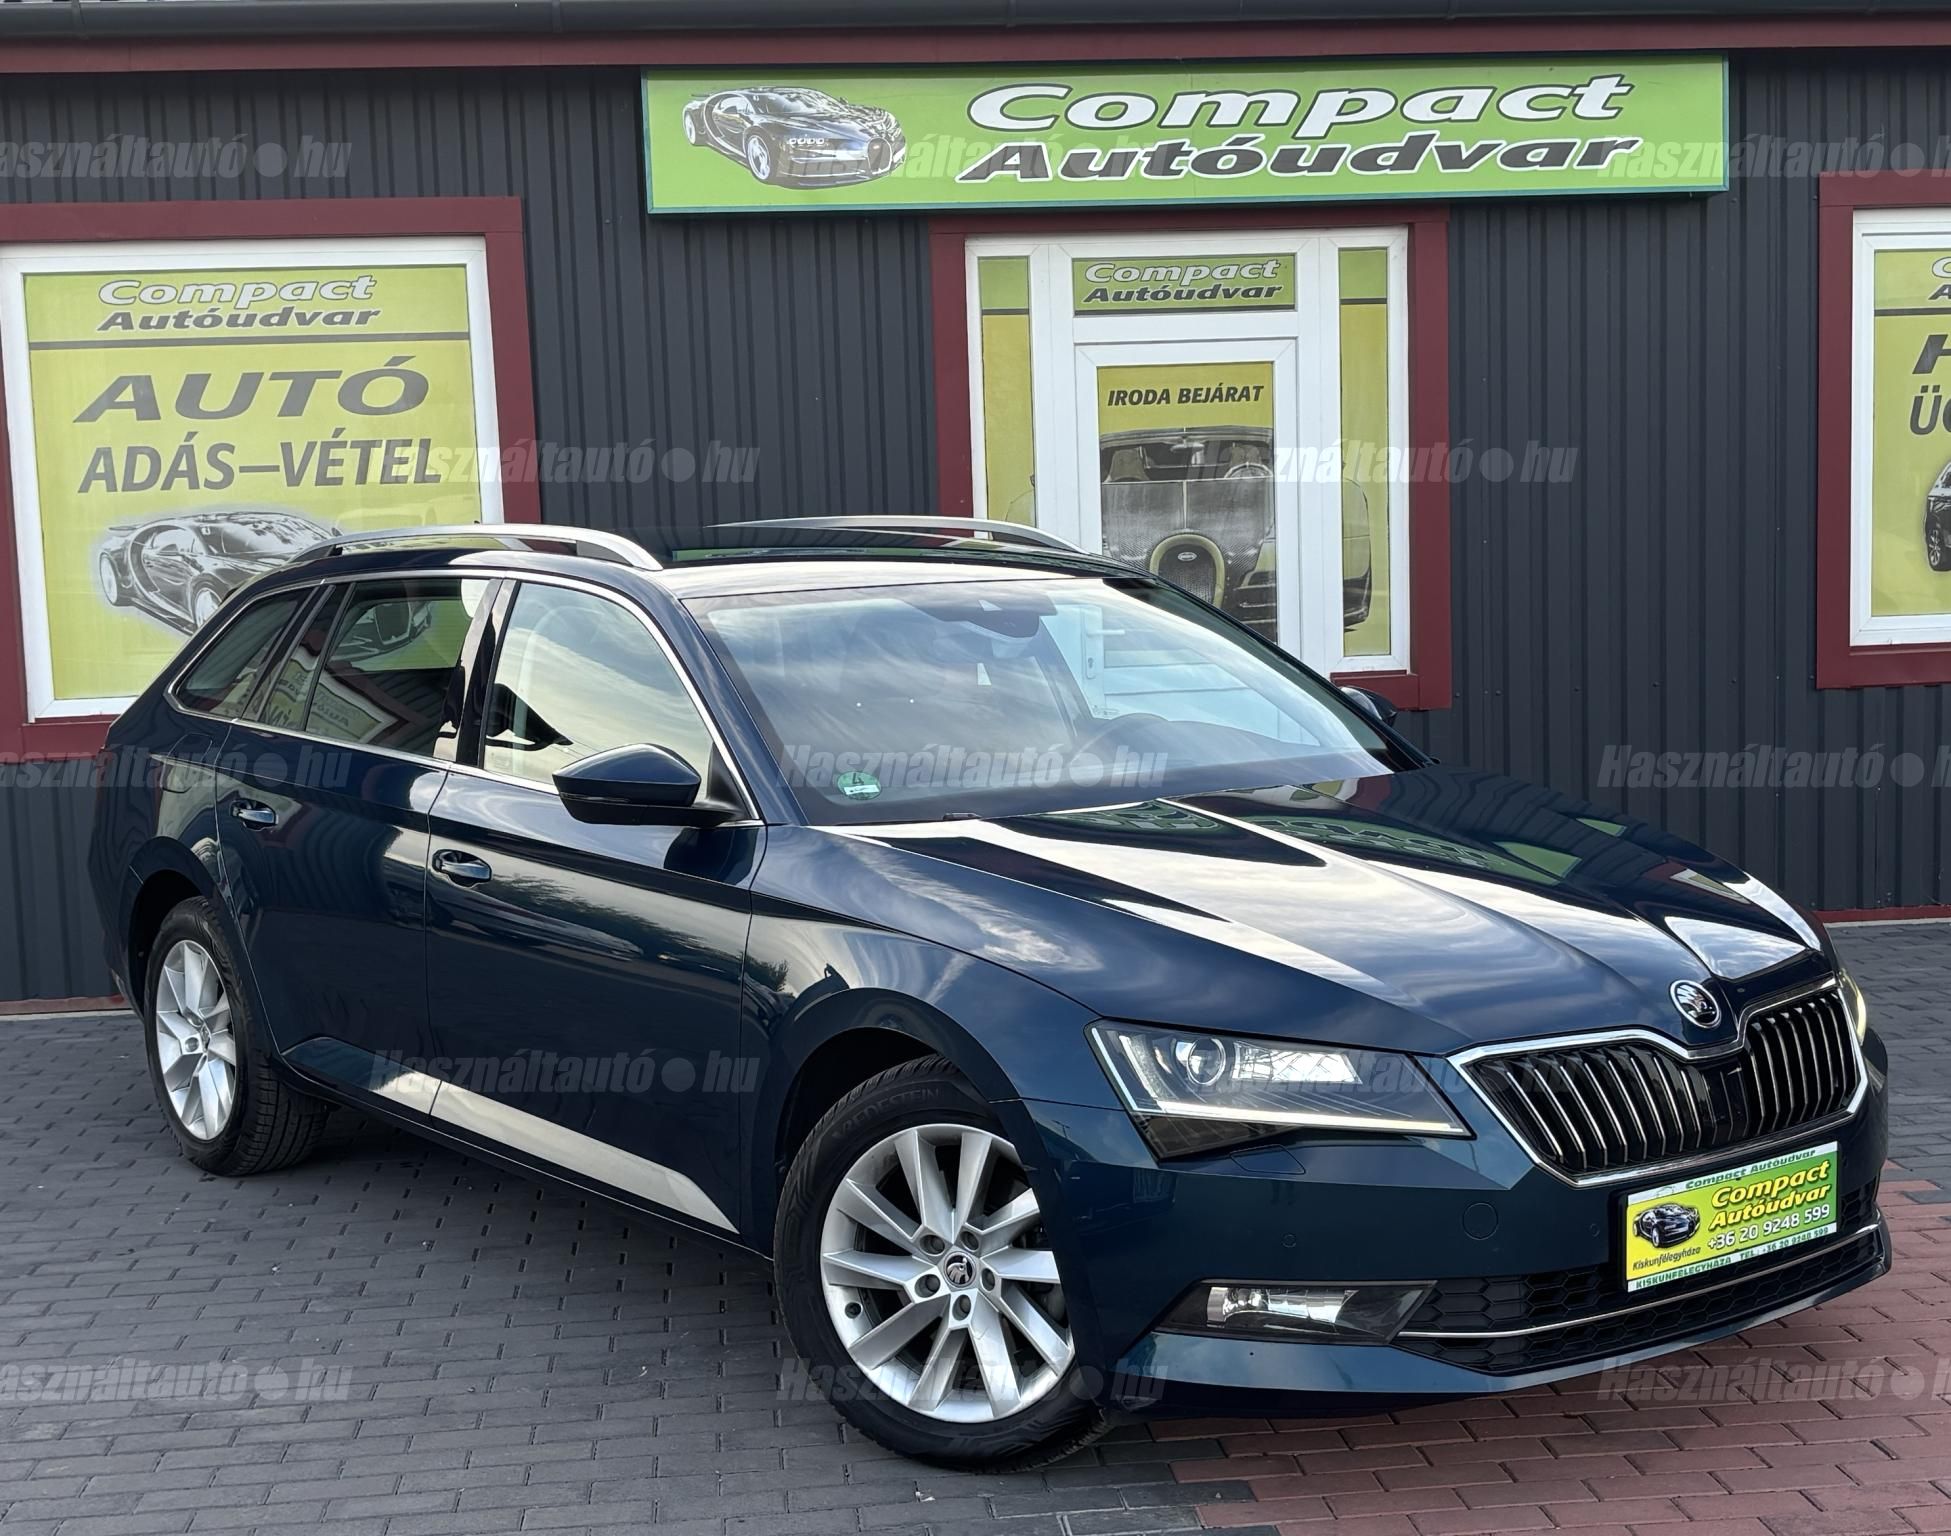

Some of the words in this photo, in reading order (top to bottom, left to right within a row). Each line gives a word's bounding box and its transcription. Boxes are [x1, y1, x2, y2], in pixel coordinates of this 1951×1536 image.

[966, 74, 1636, 139] Compact
[955, 130, 1643, 183] Autóudvar
[98, 274, 378, 309] Compact
[1083, 283, 1283, 304] Autóudvar
[1084, 259, 1282, 287] Compact
[96, 307, 381, 333] Autóudvar
[72, 355, 430, 424] AUTÓ
[1107, 388, 1171, 407] IRODA
[1177, 383, 1265, 405] BEJÁRAT
[1711, 1160, 1831, 1208] Compact
[1707, 1231, 1736, 1251] +36
[1739, 1224, 1759, 1243] 20
[1762, 1212, 1800, 1236] 9248
[1804, 1203, 1830, 1224] 599
[1708, 1184, 1831, 1231] Autóudvar
[1632, 1247, 1702, 1271] Kiskunfélegyháza
